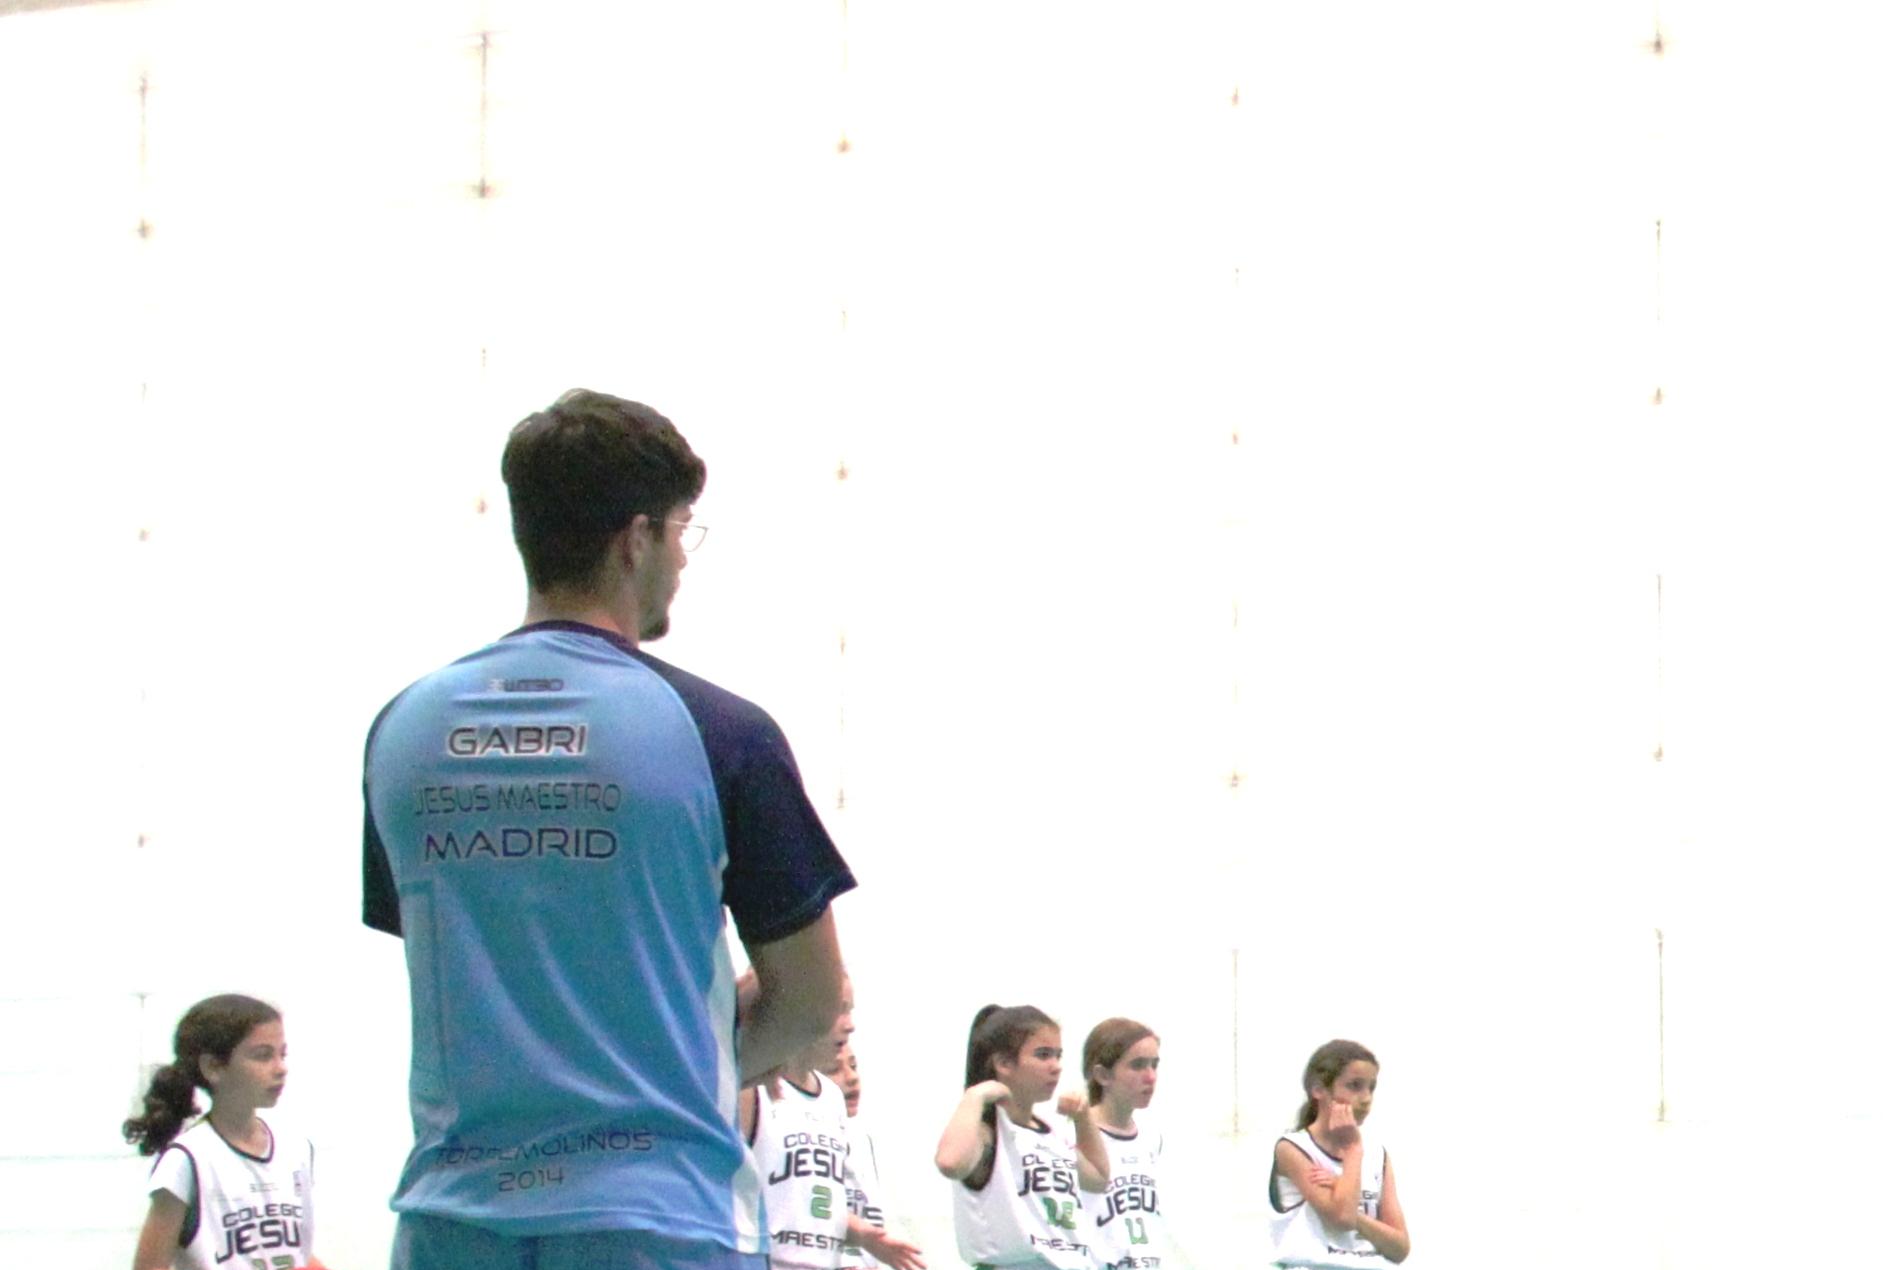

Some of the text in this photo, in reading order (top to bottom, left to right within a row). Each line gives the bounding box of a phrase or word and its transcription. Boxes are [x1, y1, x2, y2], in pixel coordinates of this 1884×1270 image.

[447, 723, 588, 757] GABRI
[498, 782, 621, 812] MAESTRO
[423, 827, 619, 861] MADRID
[498, 1168, 565, 1193] 2014
[810, 1184, 832, 1220] 2
